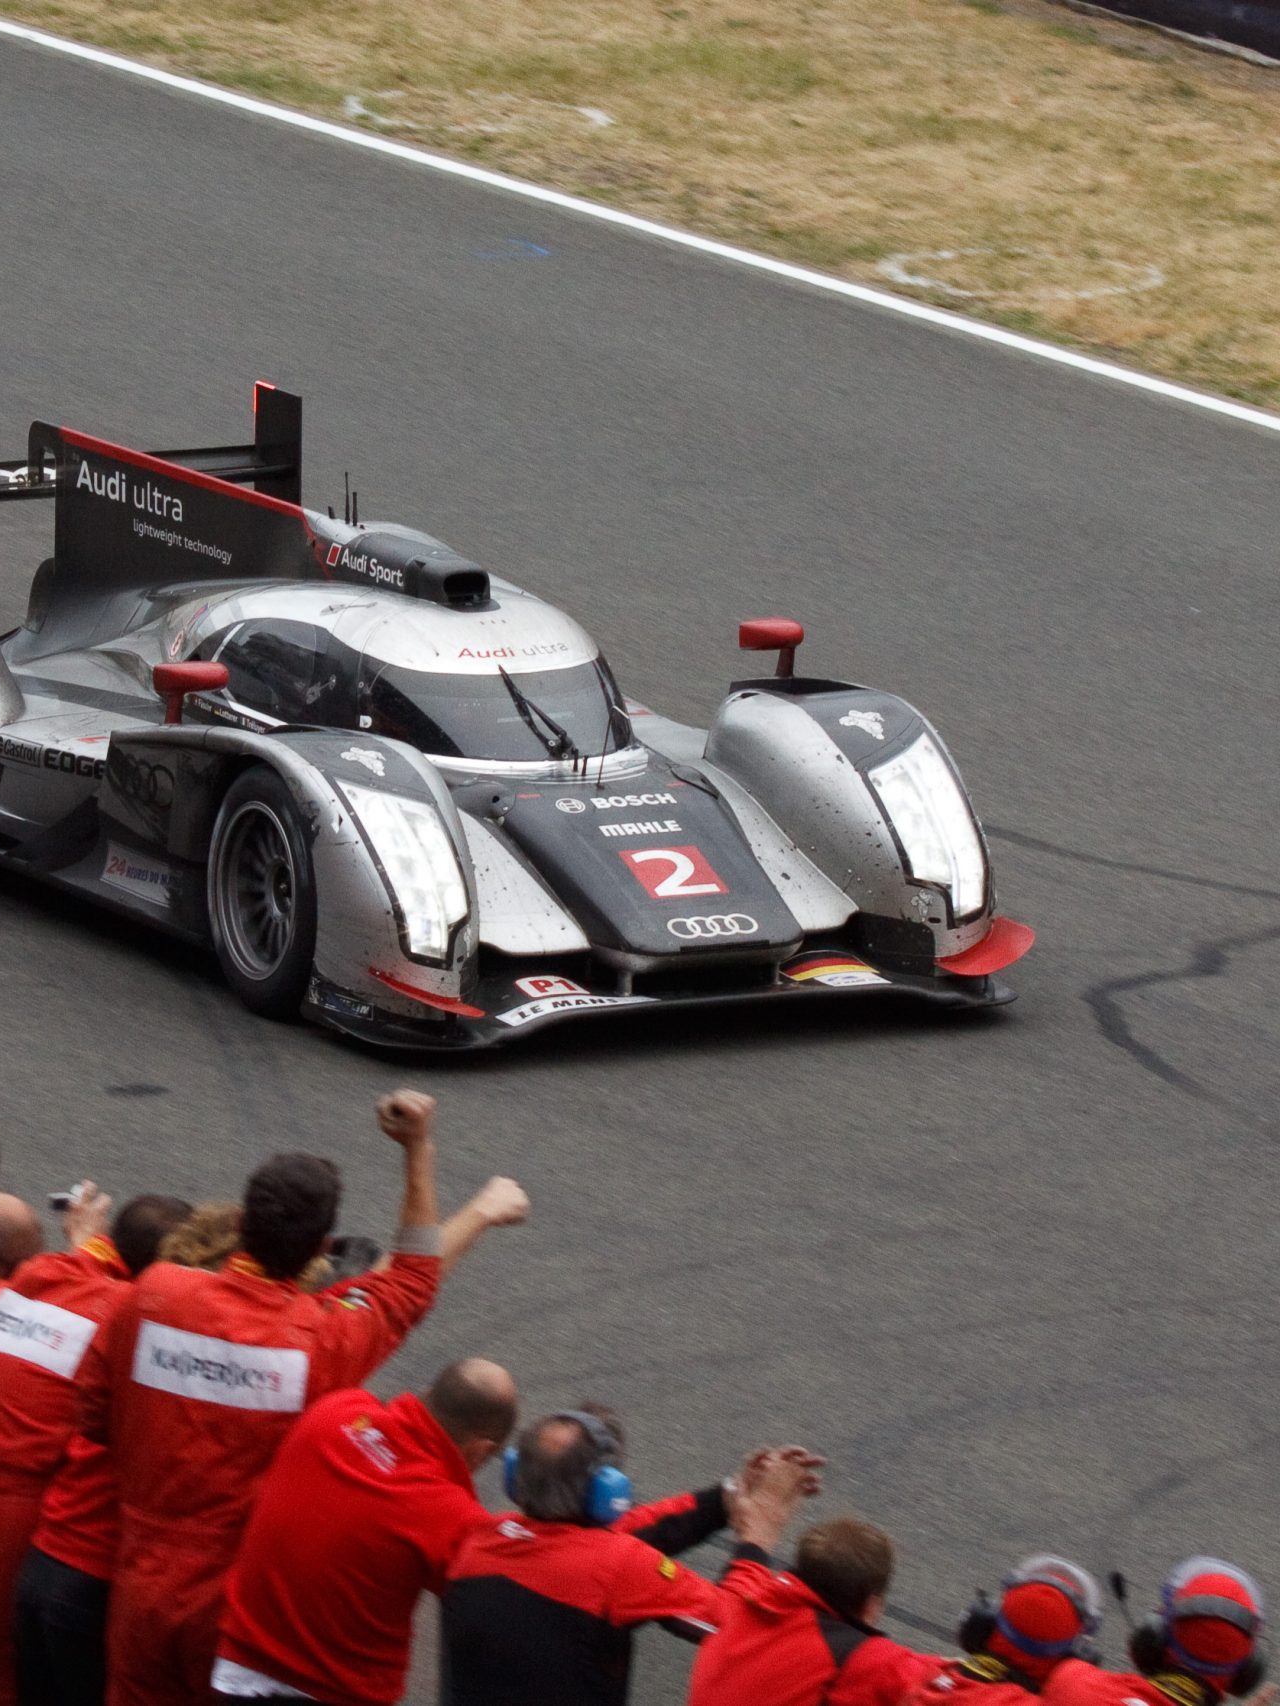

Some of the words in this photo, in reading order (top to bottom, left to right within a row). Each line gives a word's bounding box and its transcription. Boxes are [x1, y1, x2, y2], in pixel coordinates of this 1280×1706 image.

[76, 460, 127, 503] Audi
[133, 481, 183, 522] ultra
[133, 518, 182, 546] lightweight
[184, 536, 233, 565] technology
[340, 547, 368, 574] Audi
[369, 558, 404, 587] Sport
[458, 647, 516, 659] Audi
[521, 642, 569, 657] ultra
[3, 739, 38, 763] Castrol
[44, 747, 107, 779] EDGE
[590, 792, 677, 809] BOSCH
[598, 820, 682, 837] MAHLE
[106, 855, 126, 876] 24
[631, 850, 720, 897] 2
[528, 979, 578, 994] P1
[518, 1004, 544, 1019] LE
[552, 997, 619, 1009] MANS
